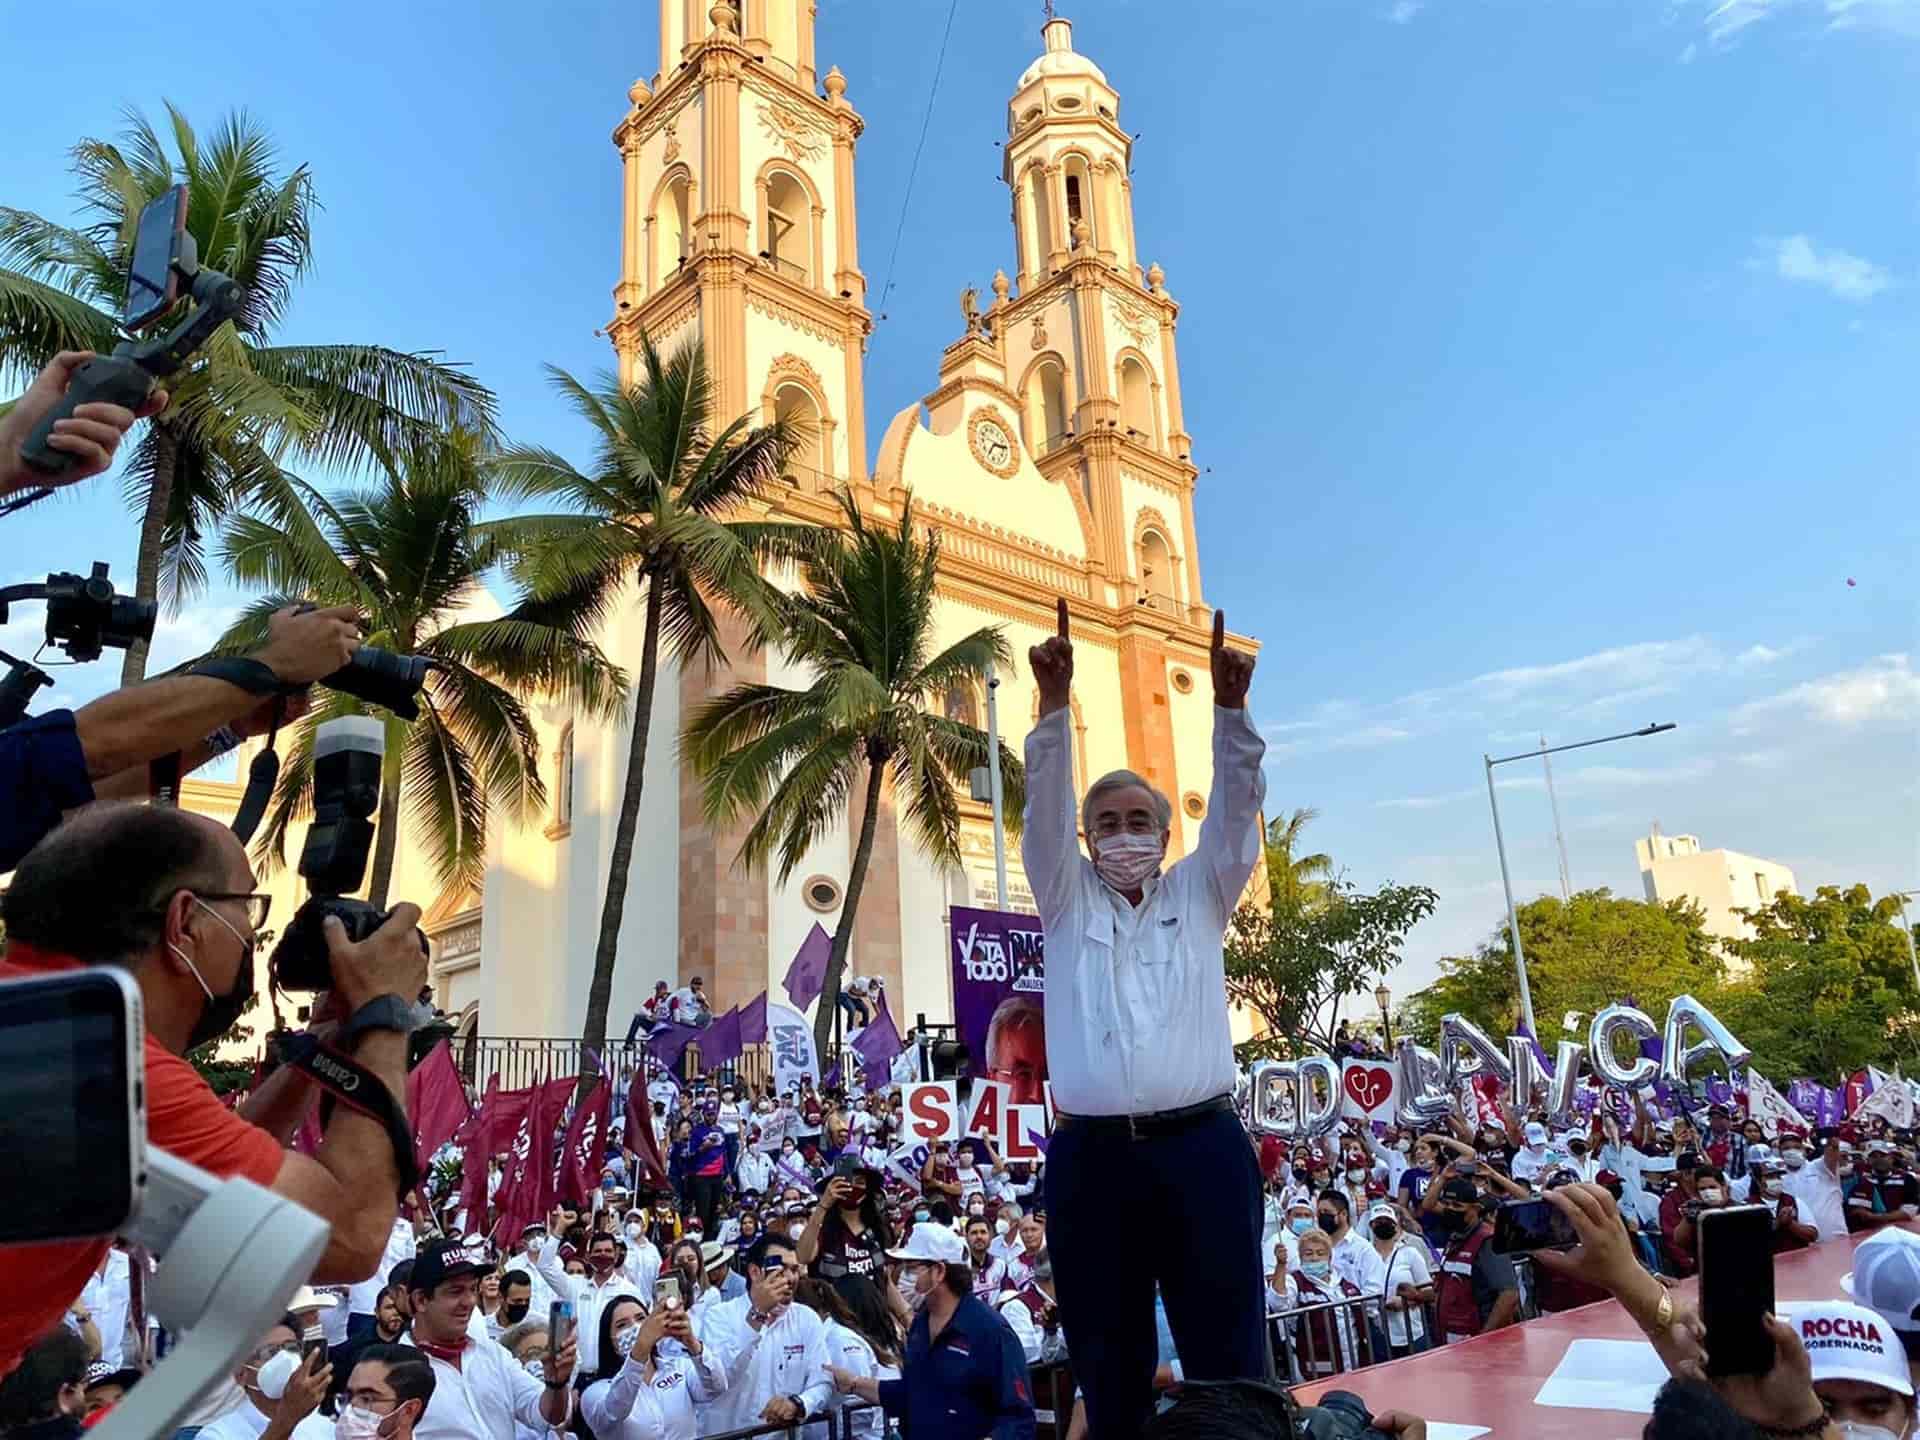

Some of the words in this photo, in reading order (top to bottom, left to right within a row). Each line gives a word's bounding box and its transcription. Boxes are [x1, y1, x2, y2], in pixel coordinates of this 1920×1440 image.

[962, 959, 1008, 982] TODO
[1802, 1318, 1883, 1343] ROCHA
[1804, 1339, 1885, 1355] GOBERNADOR
